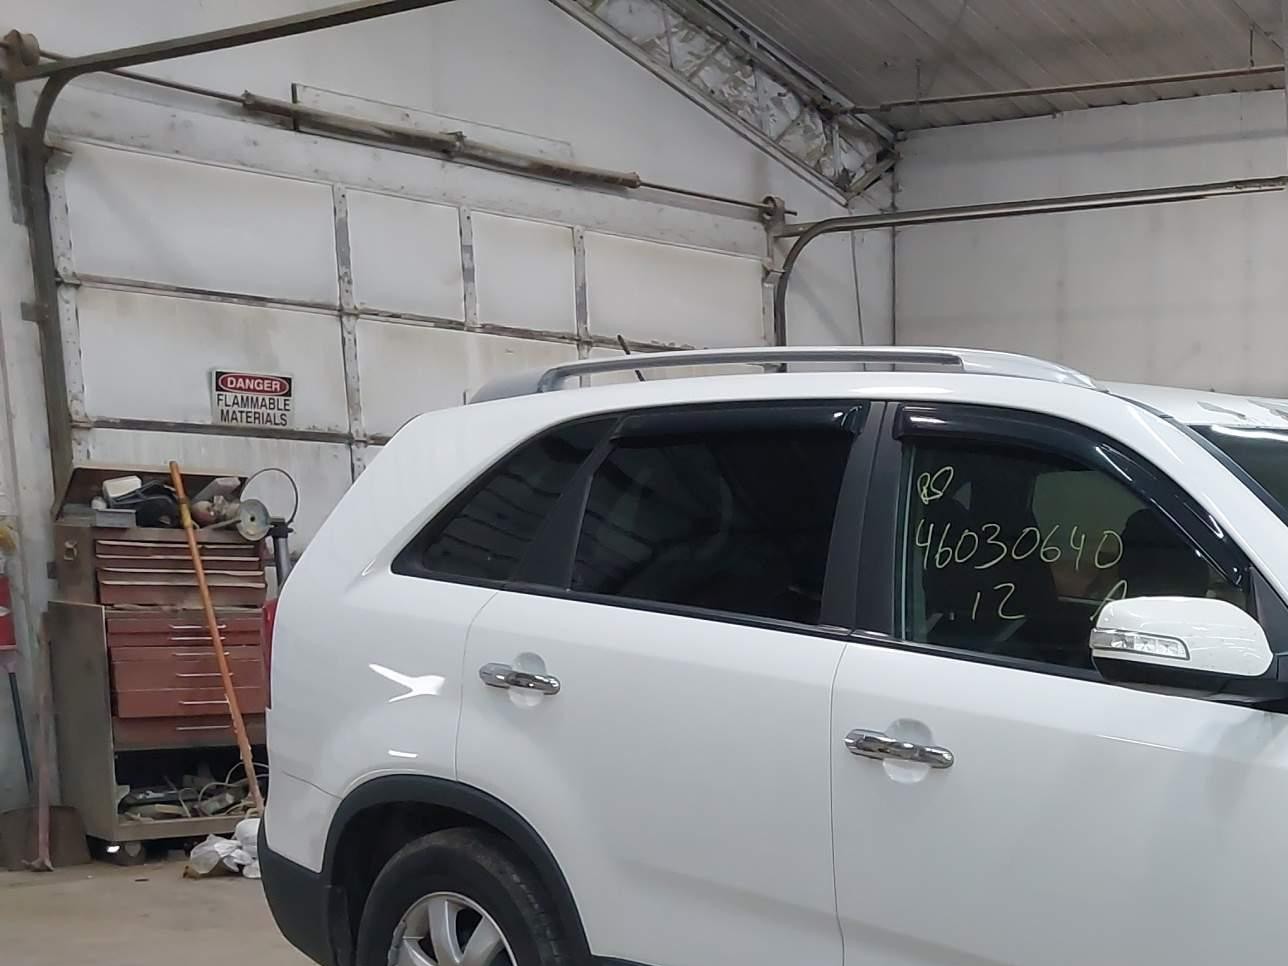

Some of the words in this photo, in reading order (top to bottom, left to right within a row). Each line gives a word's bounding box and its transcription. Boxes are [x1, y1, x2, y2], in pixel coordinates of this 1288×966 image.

[227, 377, 281, 392] DANGER
[217, 393, 291, 411] FLAMMABLE
[220, 409, 288, 426] MATERIALS
[916, 519, 1124, 570] 46030640
